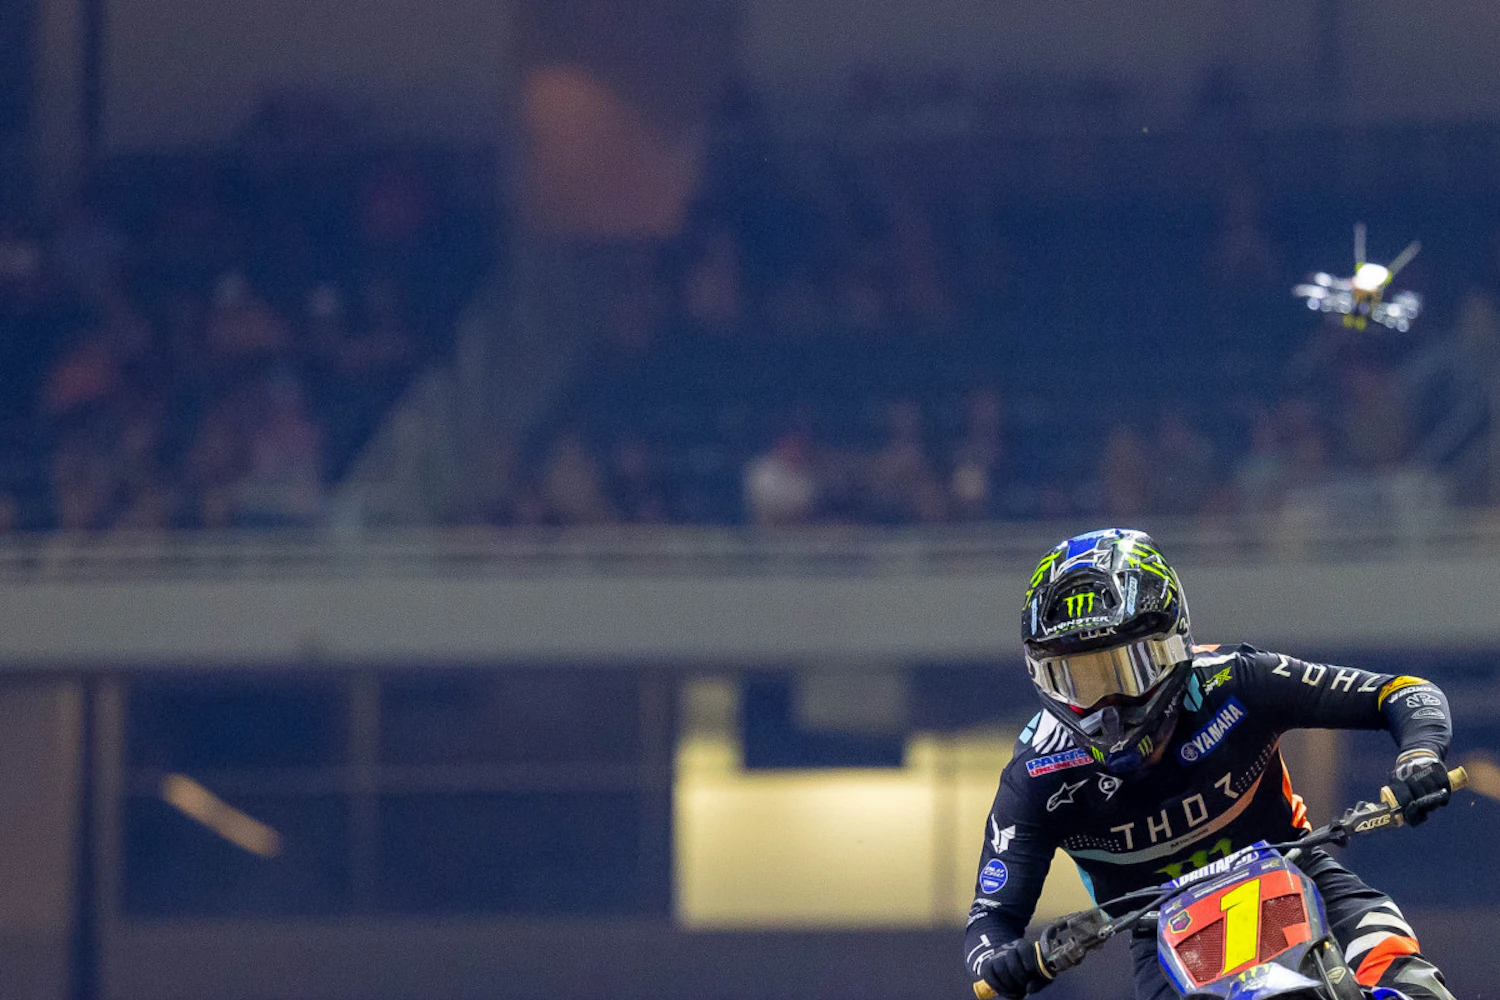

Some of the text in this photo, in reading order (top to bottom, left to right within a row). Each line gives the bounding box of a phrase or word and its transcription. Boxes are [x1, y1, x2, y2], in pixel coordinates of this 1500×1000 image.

[1191, 704, 1244, 754] YAMAHA
[1027, 748, 1088, 771] PARTS
[1030, 757, 1094, 777] UNLIMITED
[1110, 771, 1239, 850] THOR
[1354, 813, 1391, 832] ARC
[1220, 878, 1260, 976] 1
